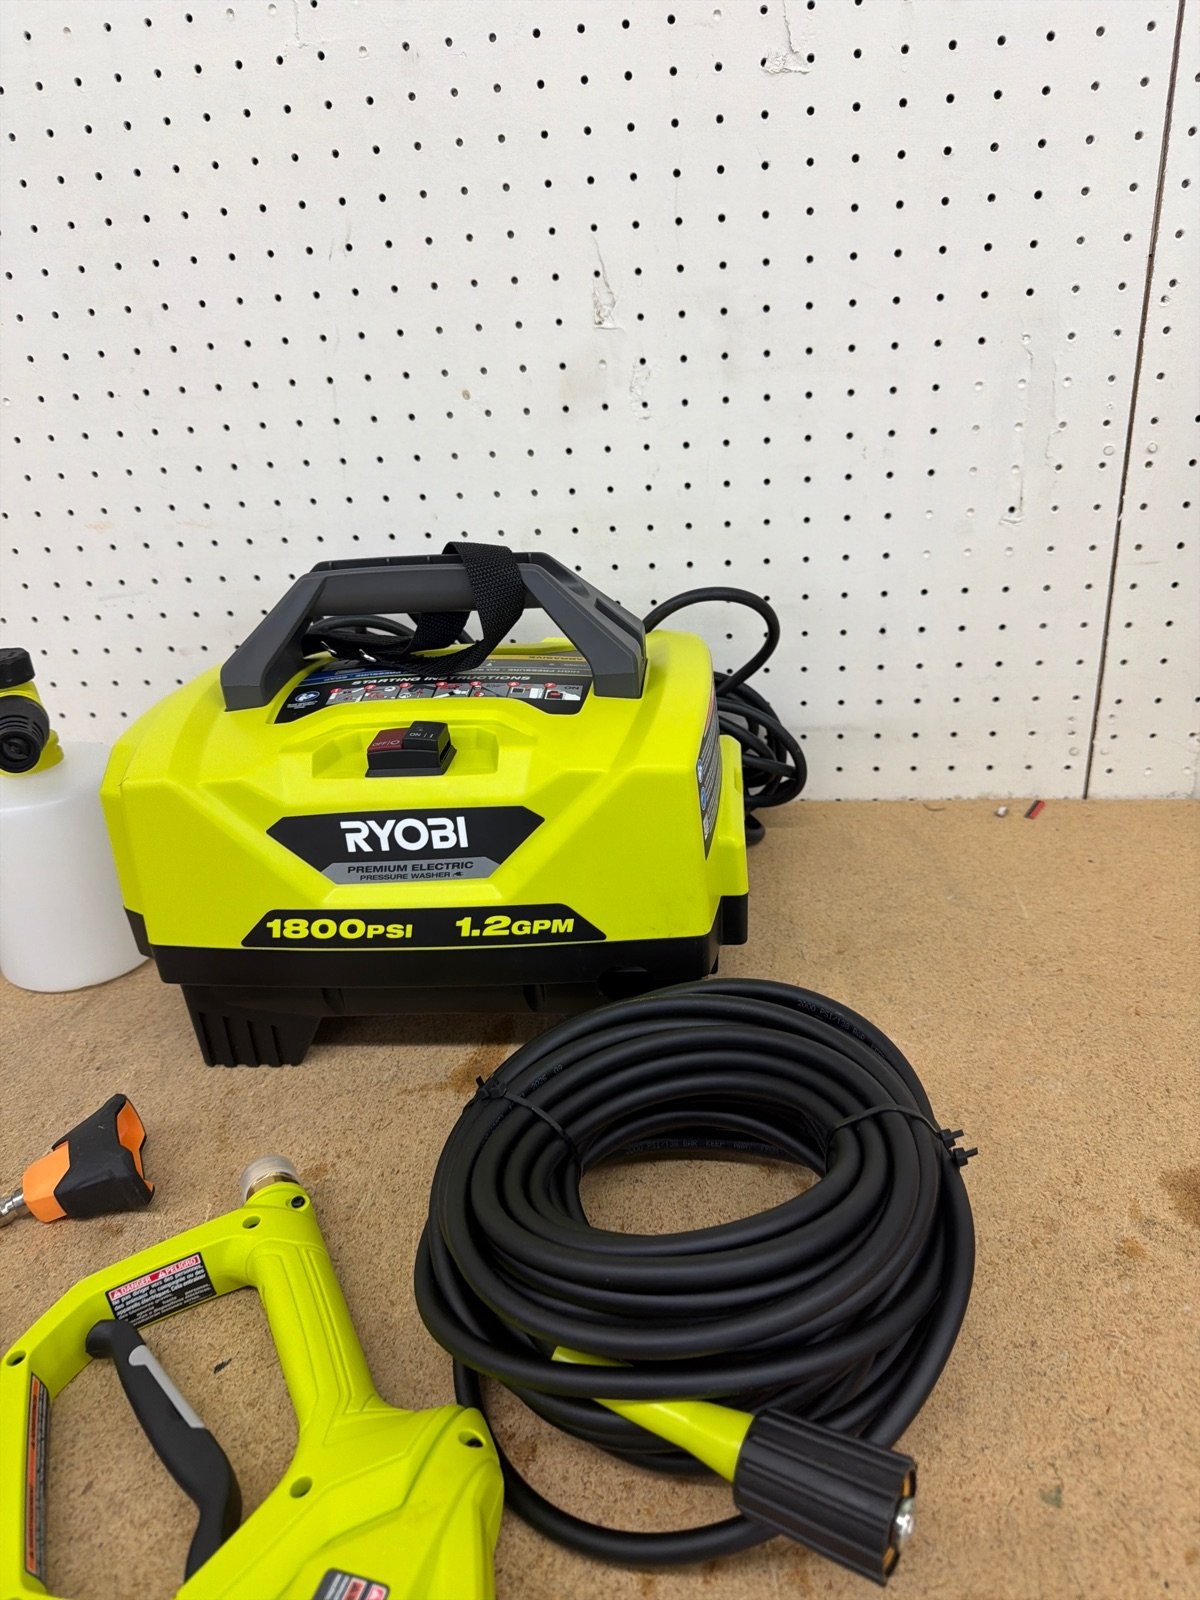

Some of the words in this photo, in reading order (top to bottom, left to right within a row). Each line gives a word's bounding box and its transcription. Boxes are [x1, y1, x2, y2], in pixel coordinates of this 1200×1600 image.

[352, 676, 421, 686] STARTING
[340, 816, 469, 853] RYOBI
[347, 864, 408, 874] PREMIUM
[411, 861, 474, 872] ELECTRIC
[360, 873, 408, 881] PRESSURE
[411, 872, 450, 880] WASHER
[266, 918, 413, 939] 1800PSI
[455, 915, 575, 937] 1.2GPM
[120, 1276, 151, 1294] DANGER
[165, 1257, 196, 1275] PELIGRO
